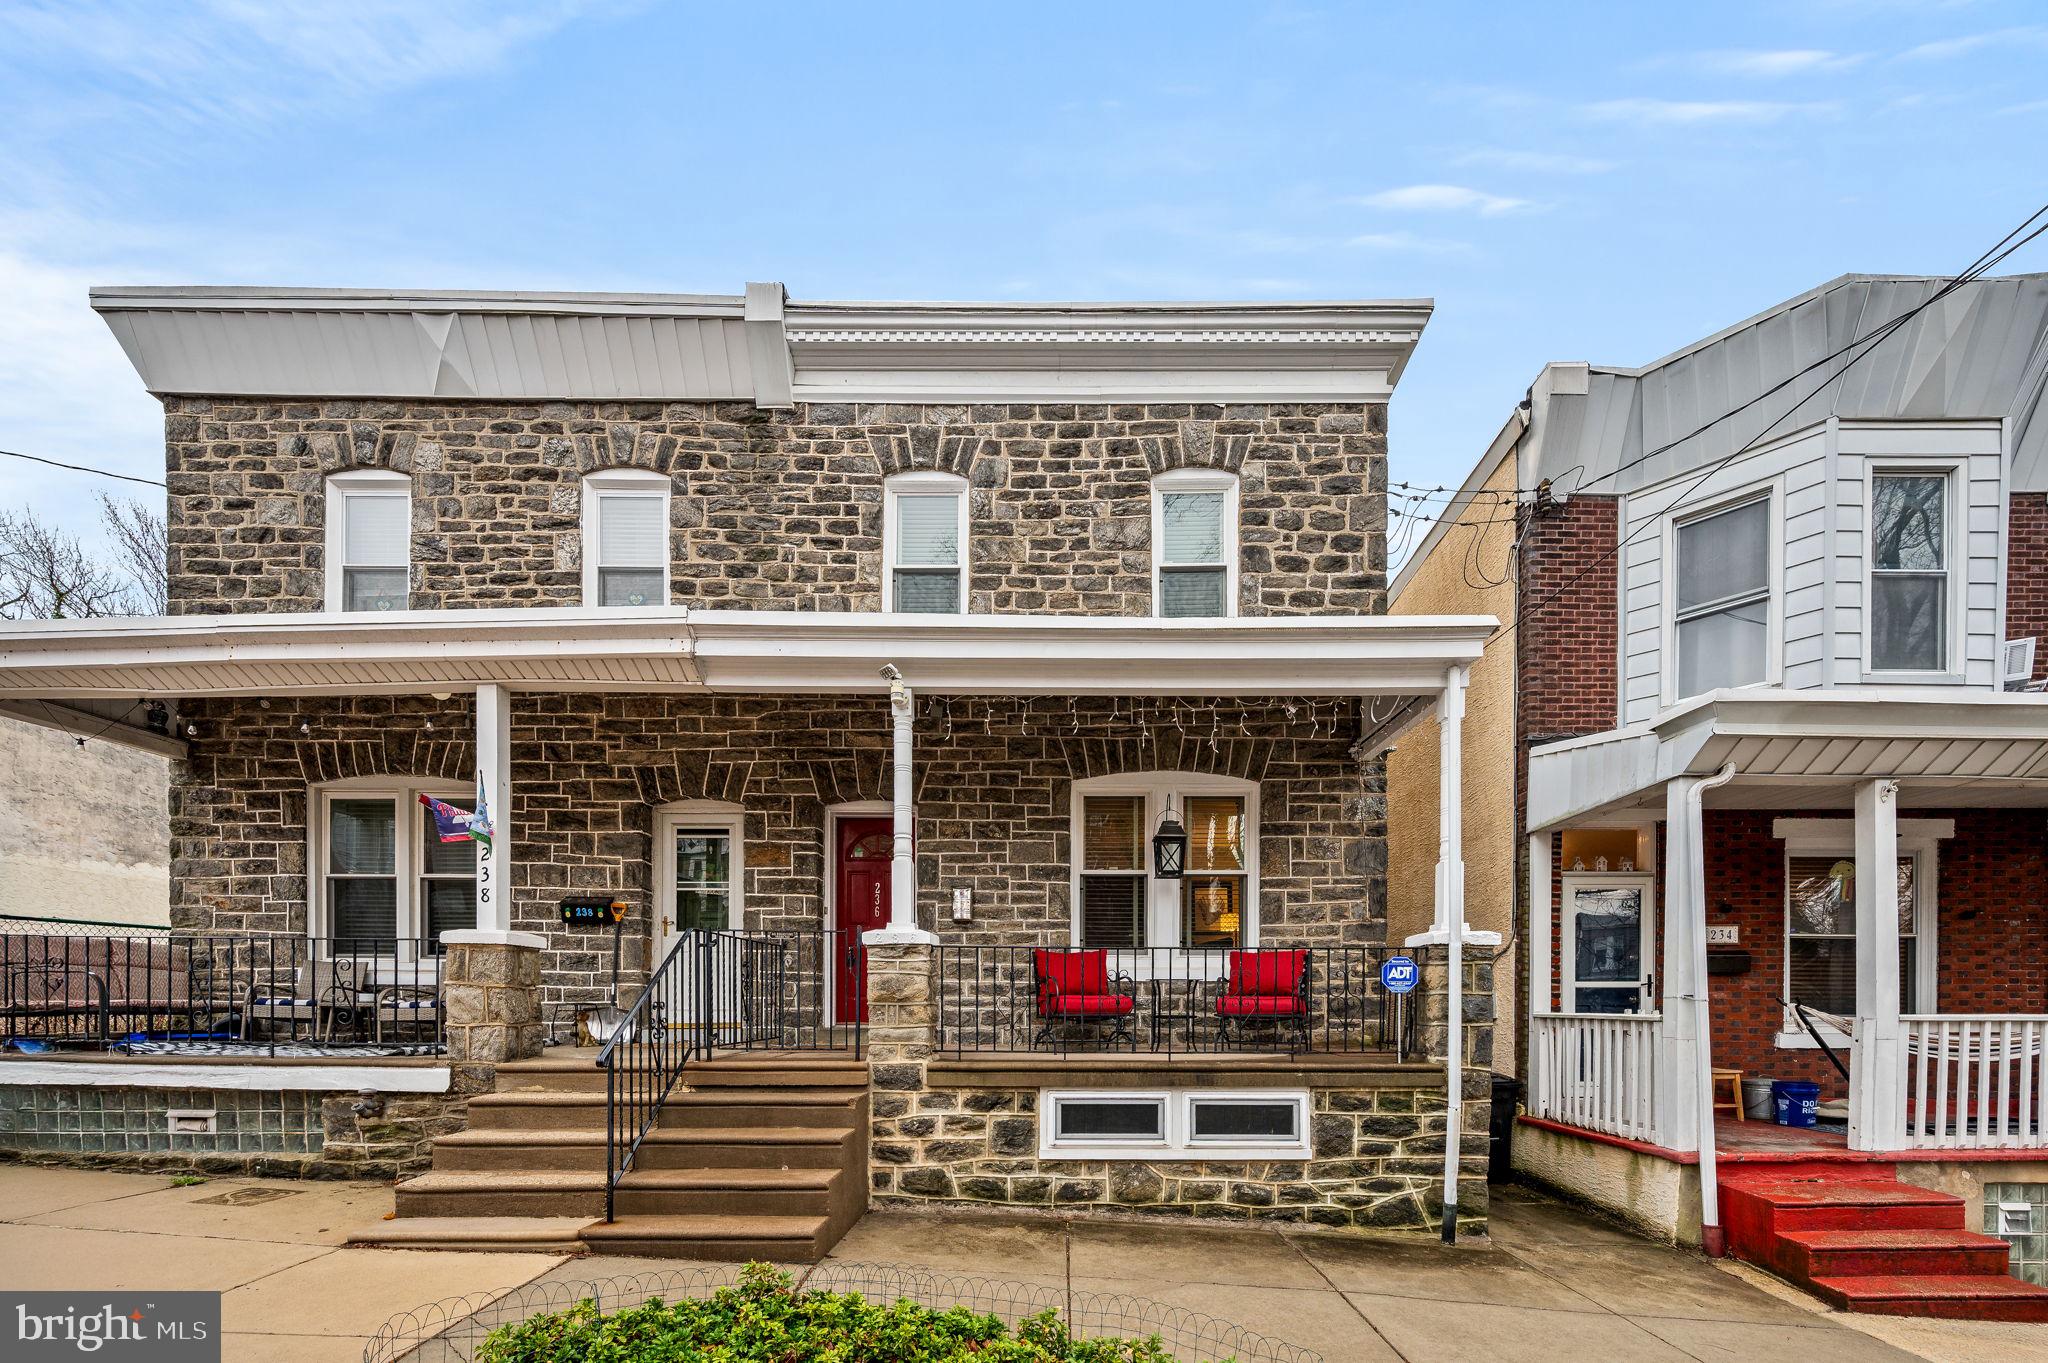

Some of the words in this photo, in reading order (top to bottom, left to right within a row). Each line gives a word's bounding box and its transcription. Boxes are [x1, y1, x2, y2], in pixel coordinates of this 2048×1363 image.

[480, 847, 490, 903] 238
[576, 907, 593, 917] 238
[1710, 929, 1732, 940] 234
[1388, 966, 1412, 979] ADT
